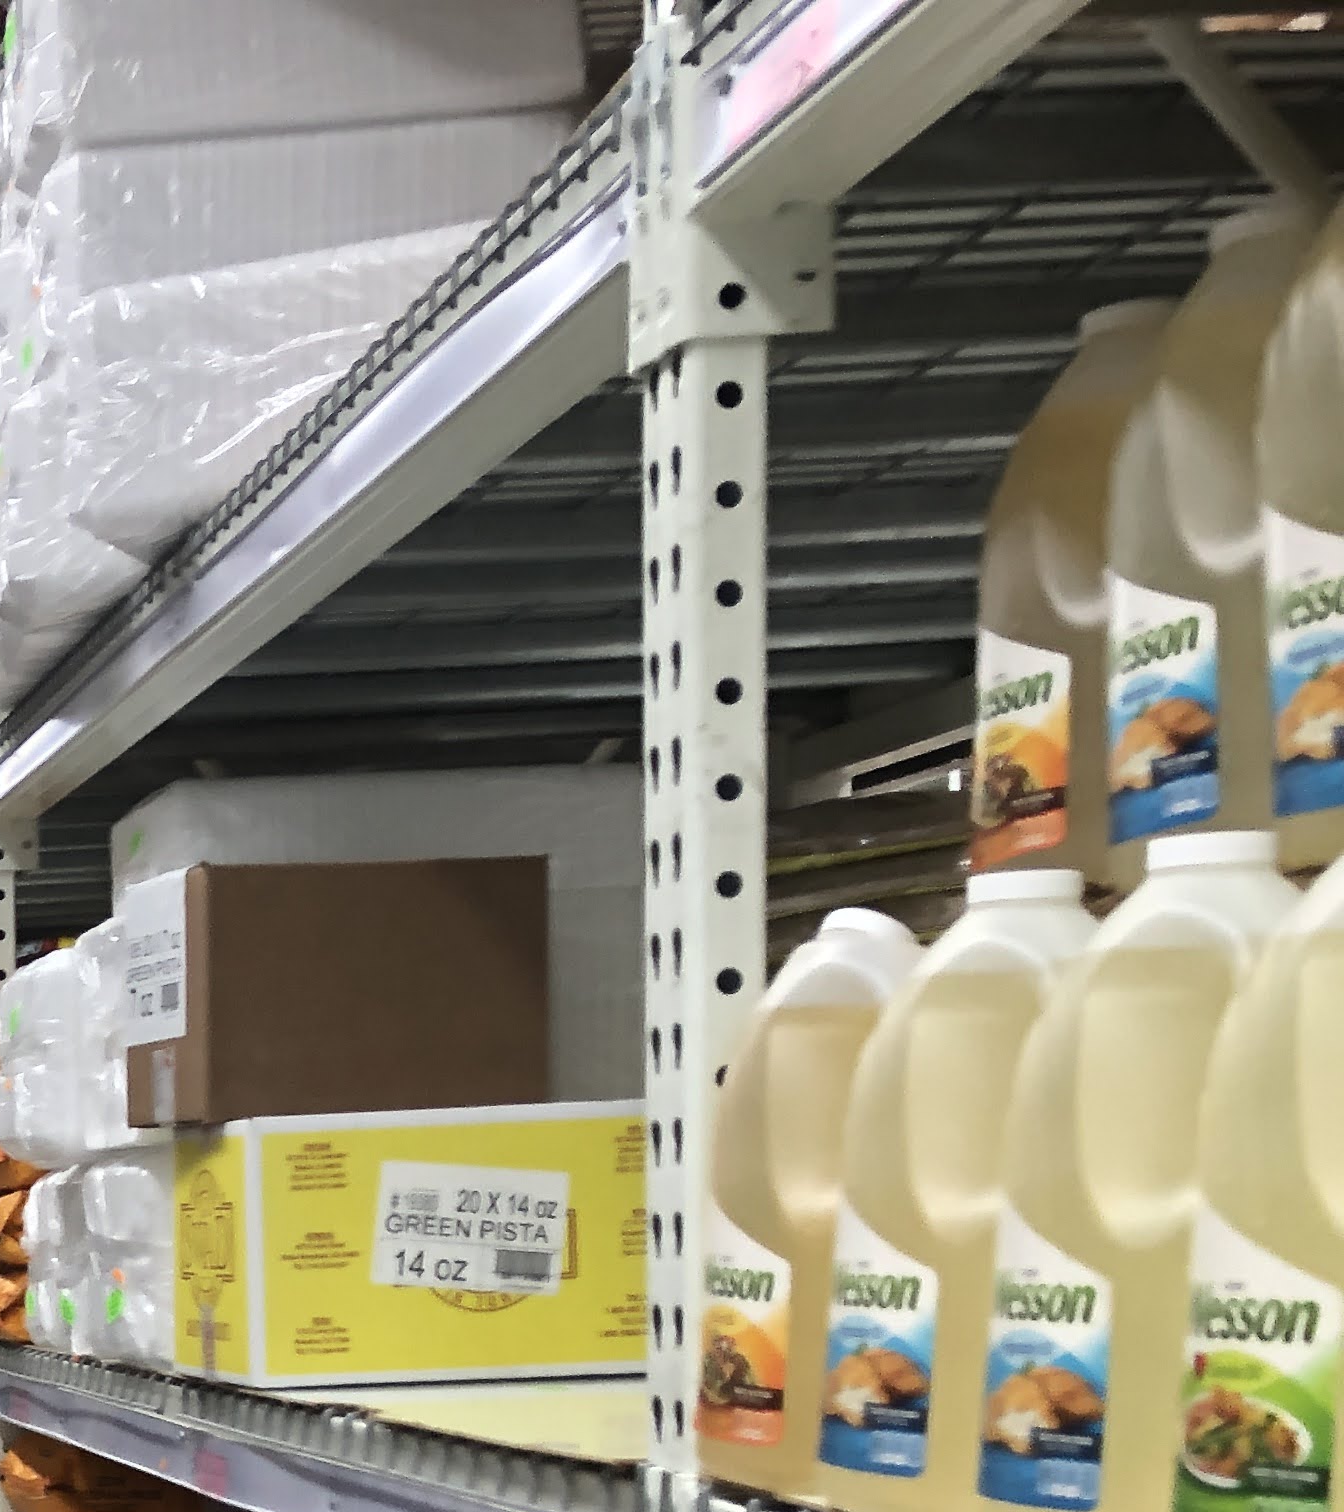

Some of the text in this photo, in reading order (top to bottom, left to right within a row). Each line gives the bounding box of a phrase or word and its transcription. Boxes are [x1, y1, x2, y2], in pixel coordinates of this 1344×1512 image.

[384, 1213, 550, 1244] GREEN PISTA
[394, 1249, 426, 1278] 14
